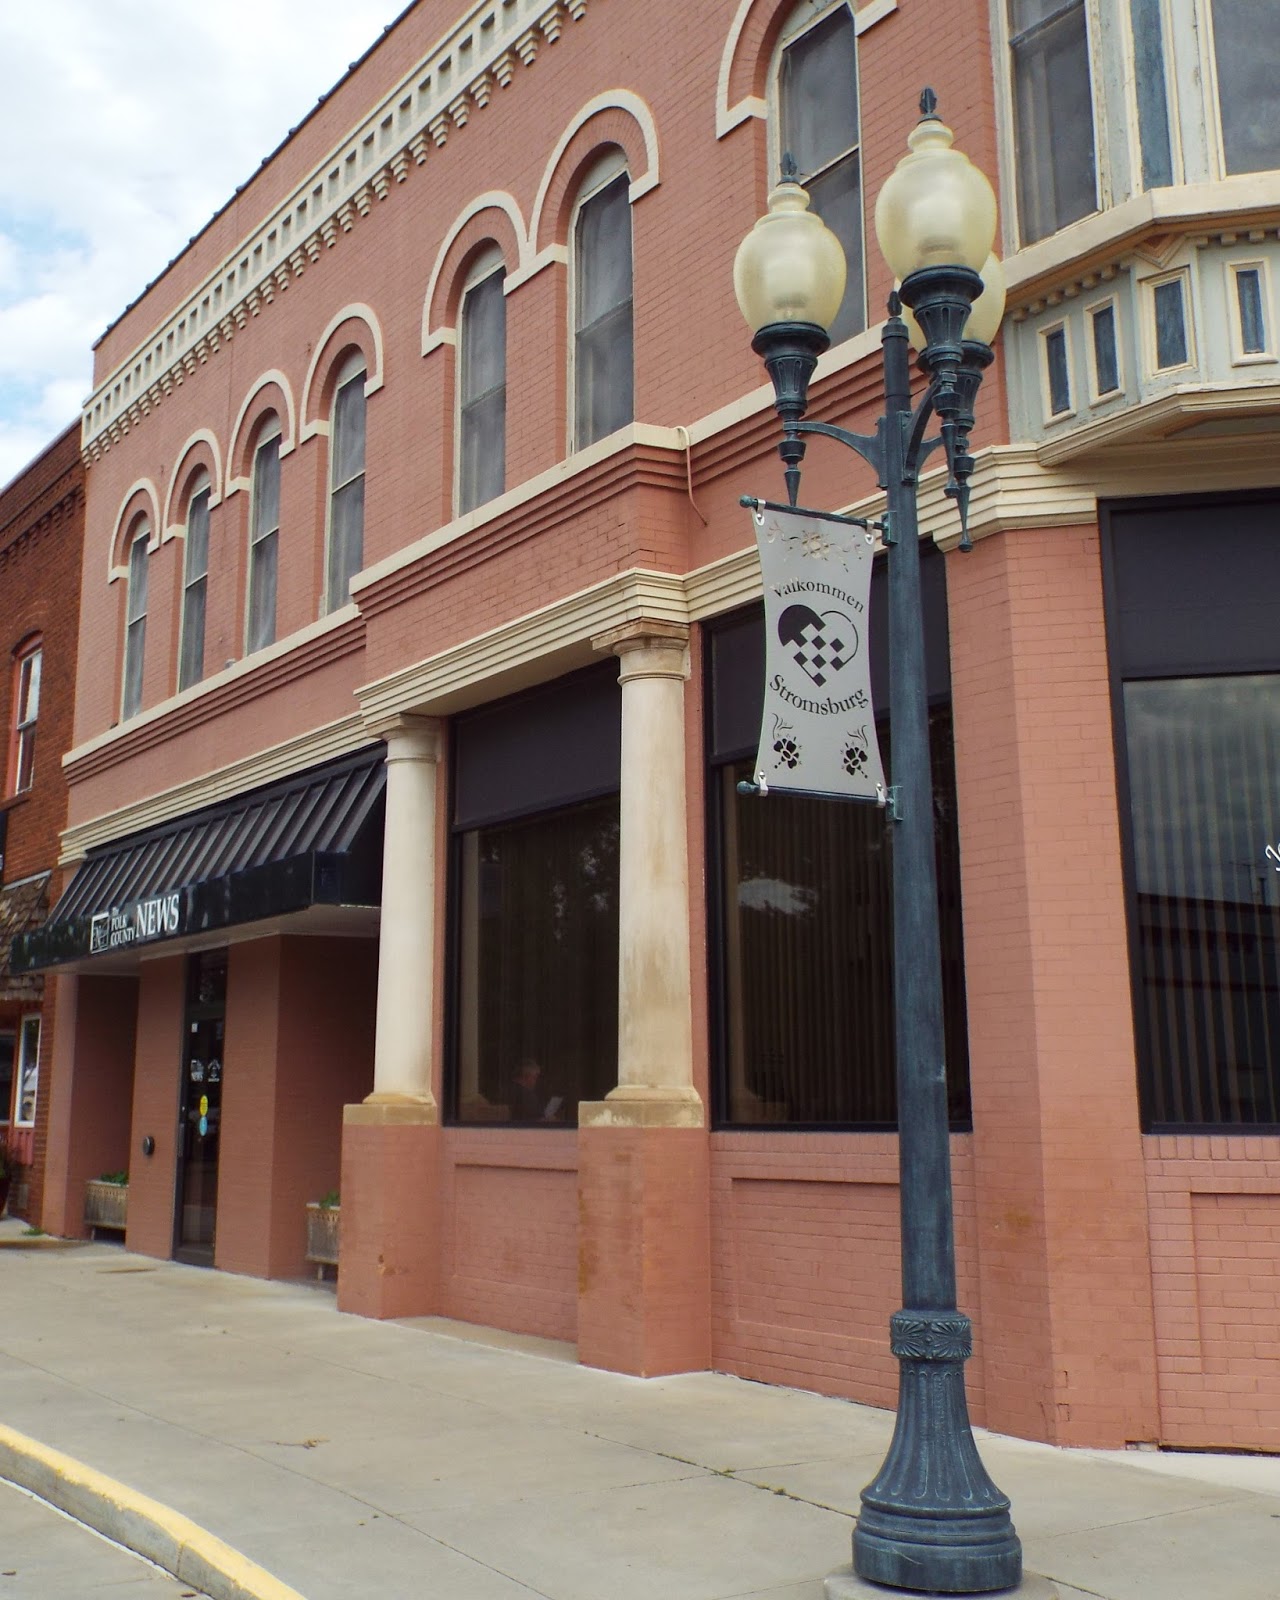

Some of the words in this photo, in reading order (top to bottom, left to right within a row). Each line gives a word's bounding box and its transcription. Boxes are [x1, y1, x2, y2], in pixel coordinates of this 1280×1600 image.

[769, 674, 869, 716] Stromsburg
[111, 914, 127, 932] POLK
[135, 894, 180, 938] NEWS
[110, 927, 135, 946] COUNTY
